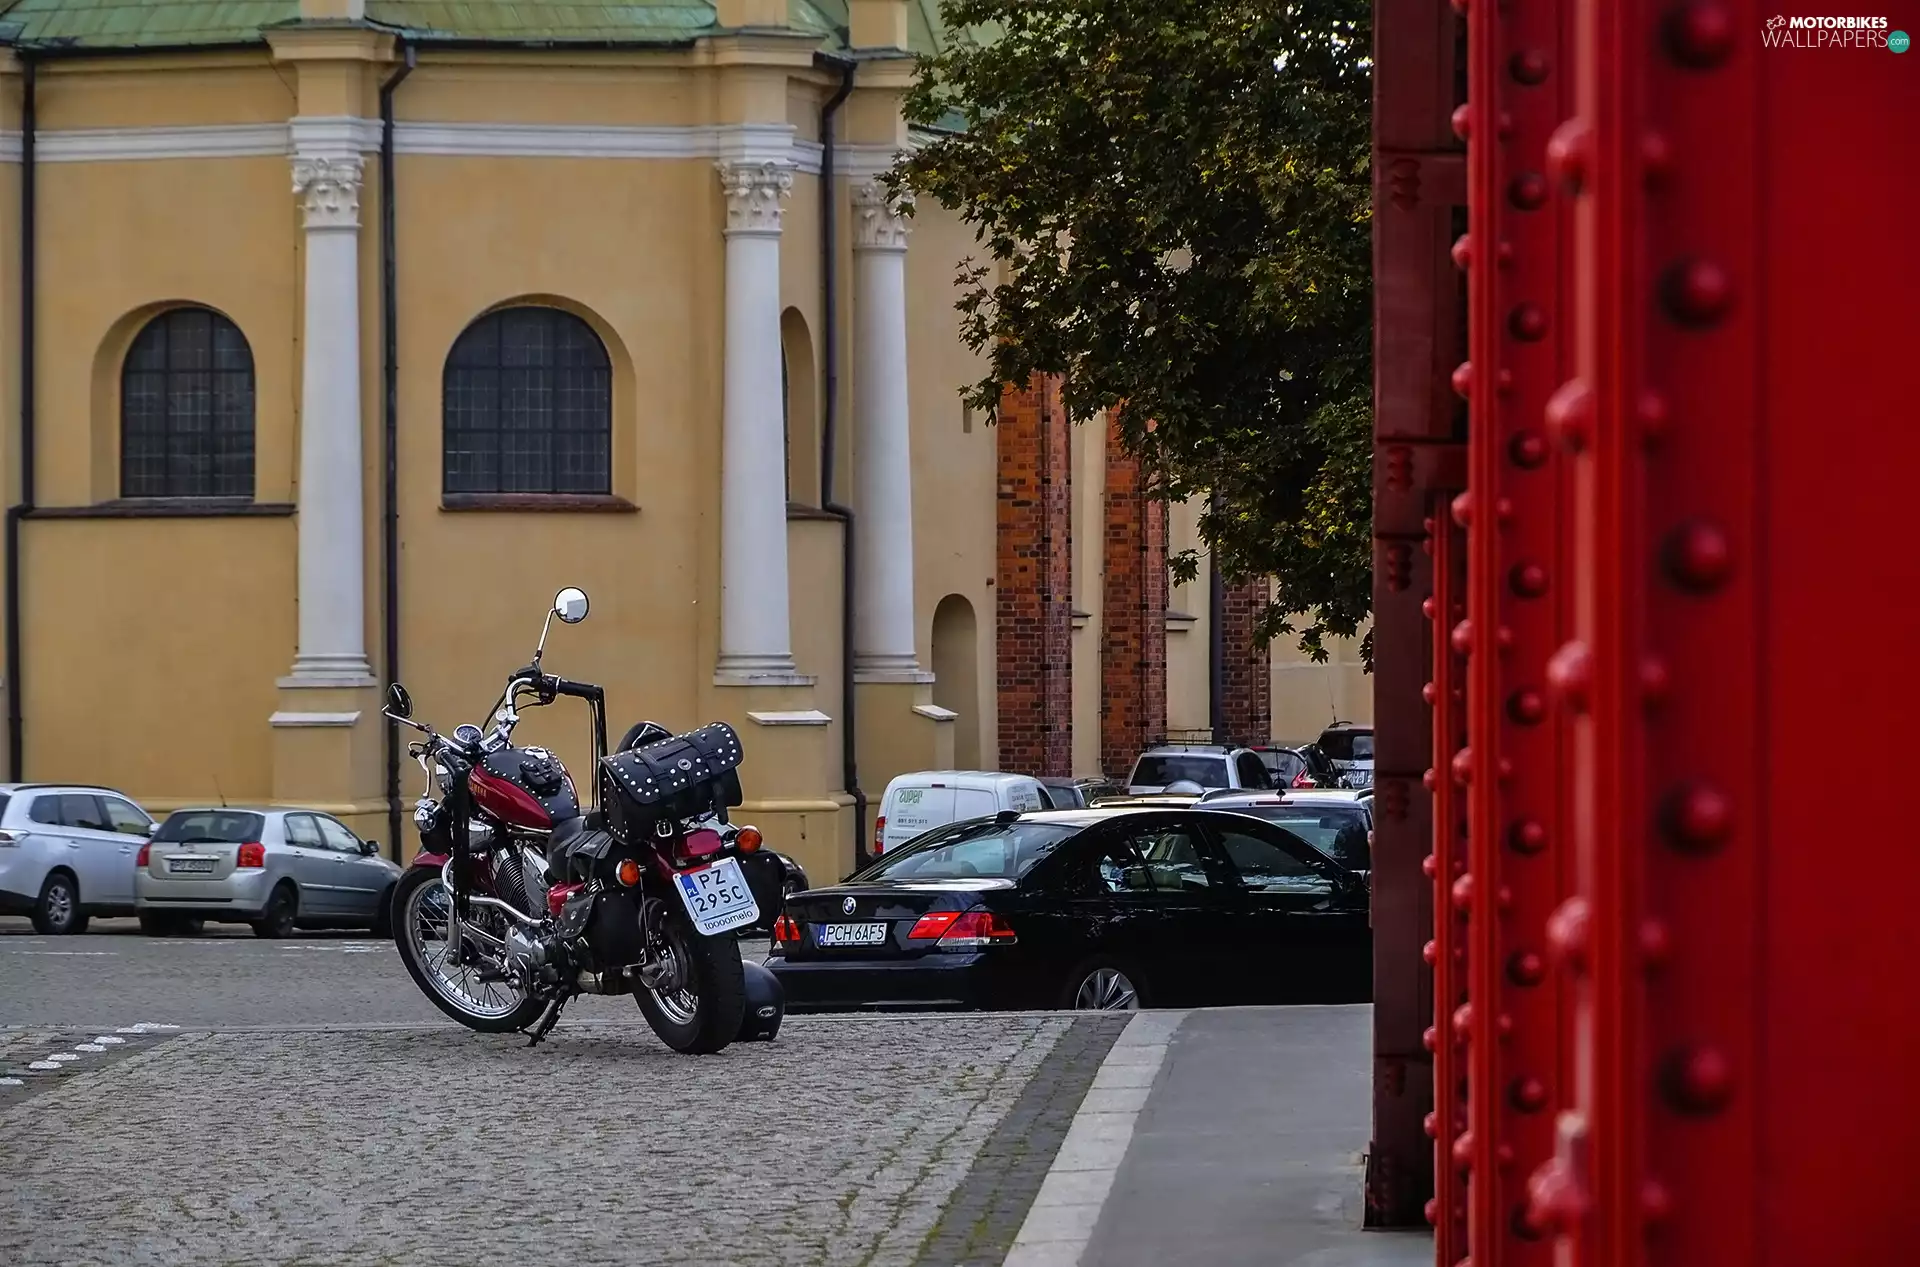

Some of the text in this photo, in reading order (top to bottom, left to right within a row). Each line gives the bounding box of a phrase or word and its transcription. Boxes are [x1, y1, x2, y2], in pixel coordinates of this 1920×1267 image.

[698, 869, 726, 889] PZ
[695, 885, 745, 912] 295C
[826, 925, 853, 941] PCH
[855, 925, 885, 940] 6AF5
